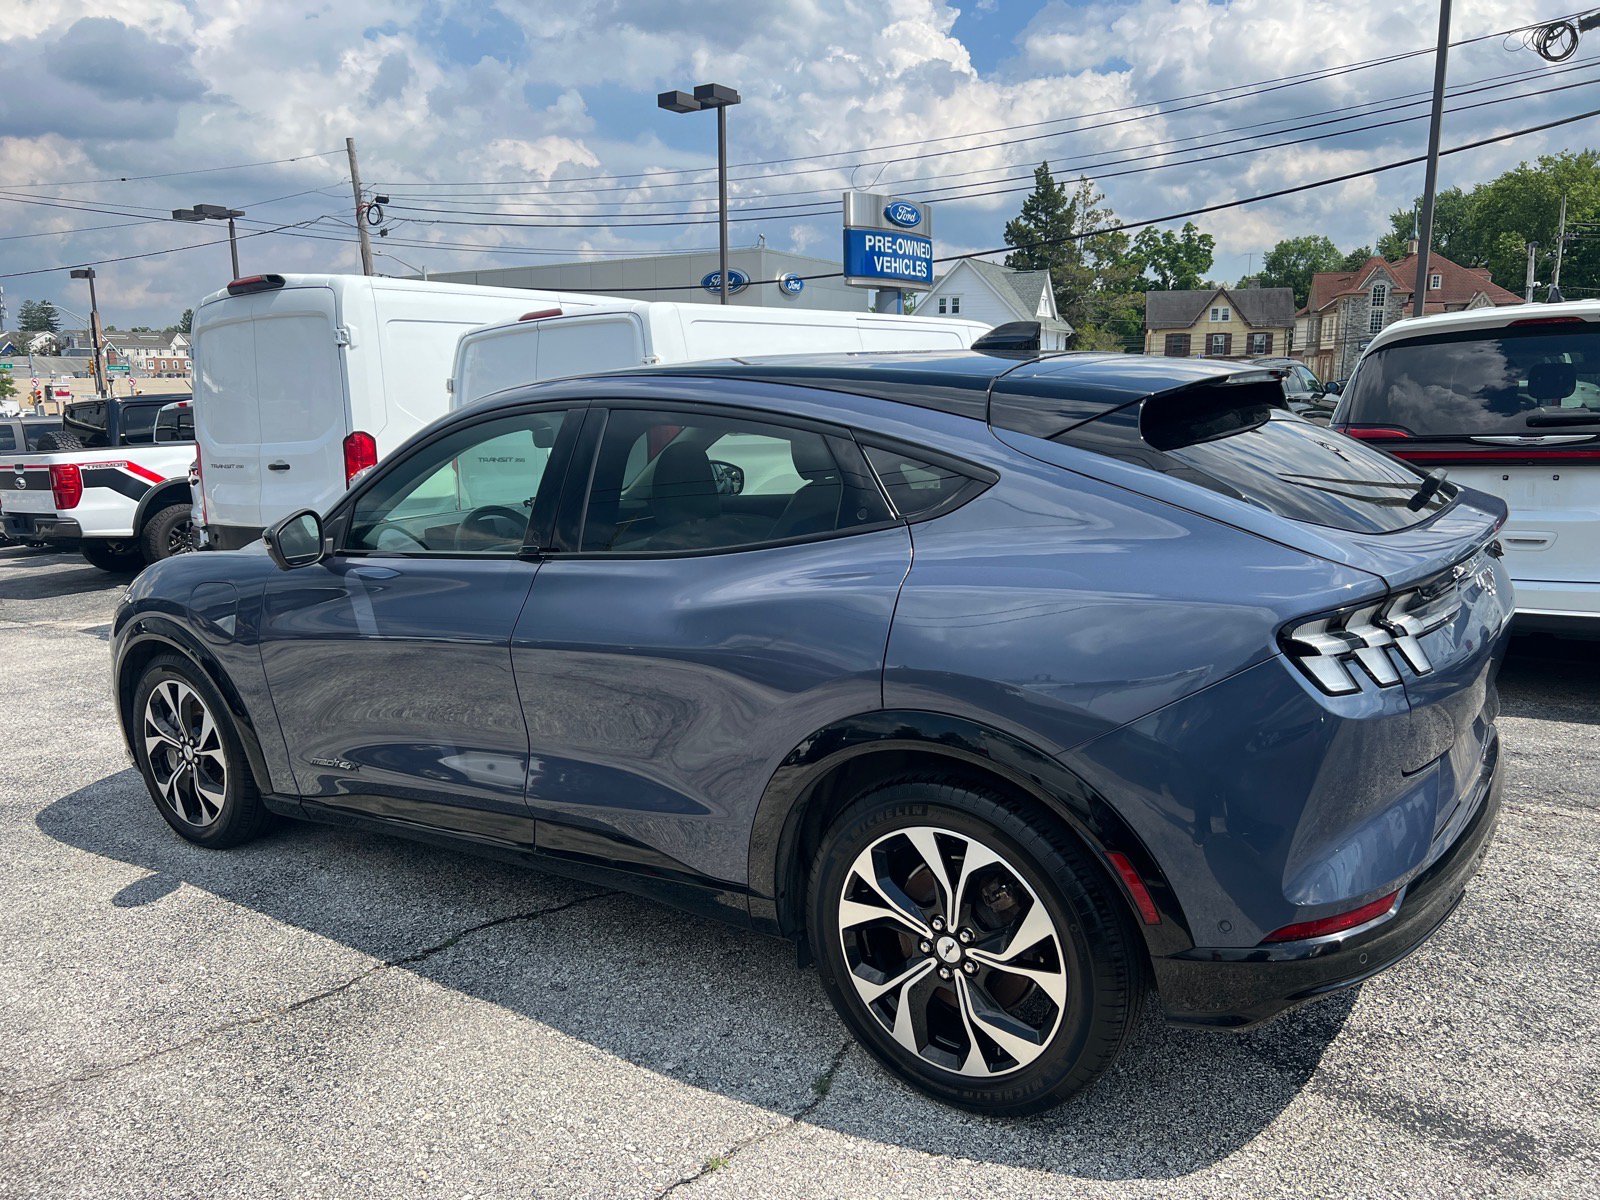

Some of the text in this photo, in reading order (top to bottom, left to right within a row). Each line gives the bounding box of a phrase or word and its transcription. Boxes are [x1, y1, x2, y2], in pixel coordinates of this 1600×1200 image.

[896, 205, 917, 223] Ford
[865, 235, 931, 259] PRE-OWNED
[874, 256, 927, 278] VEHICLES
[85, 461, 128, 469] TREMOR
